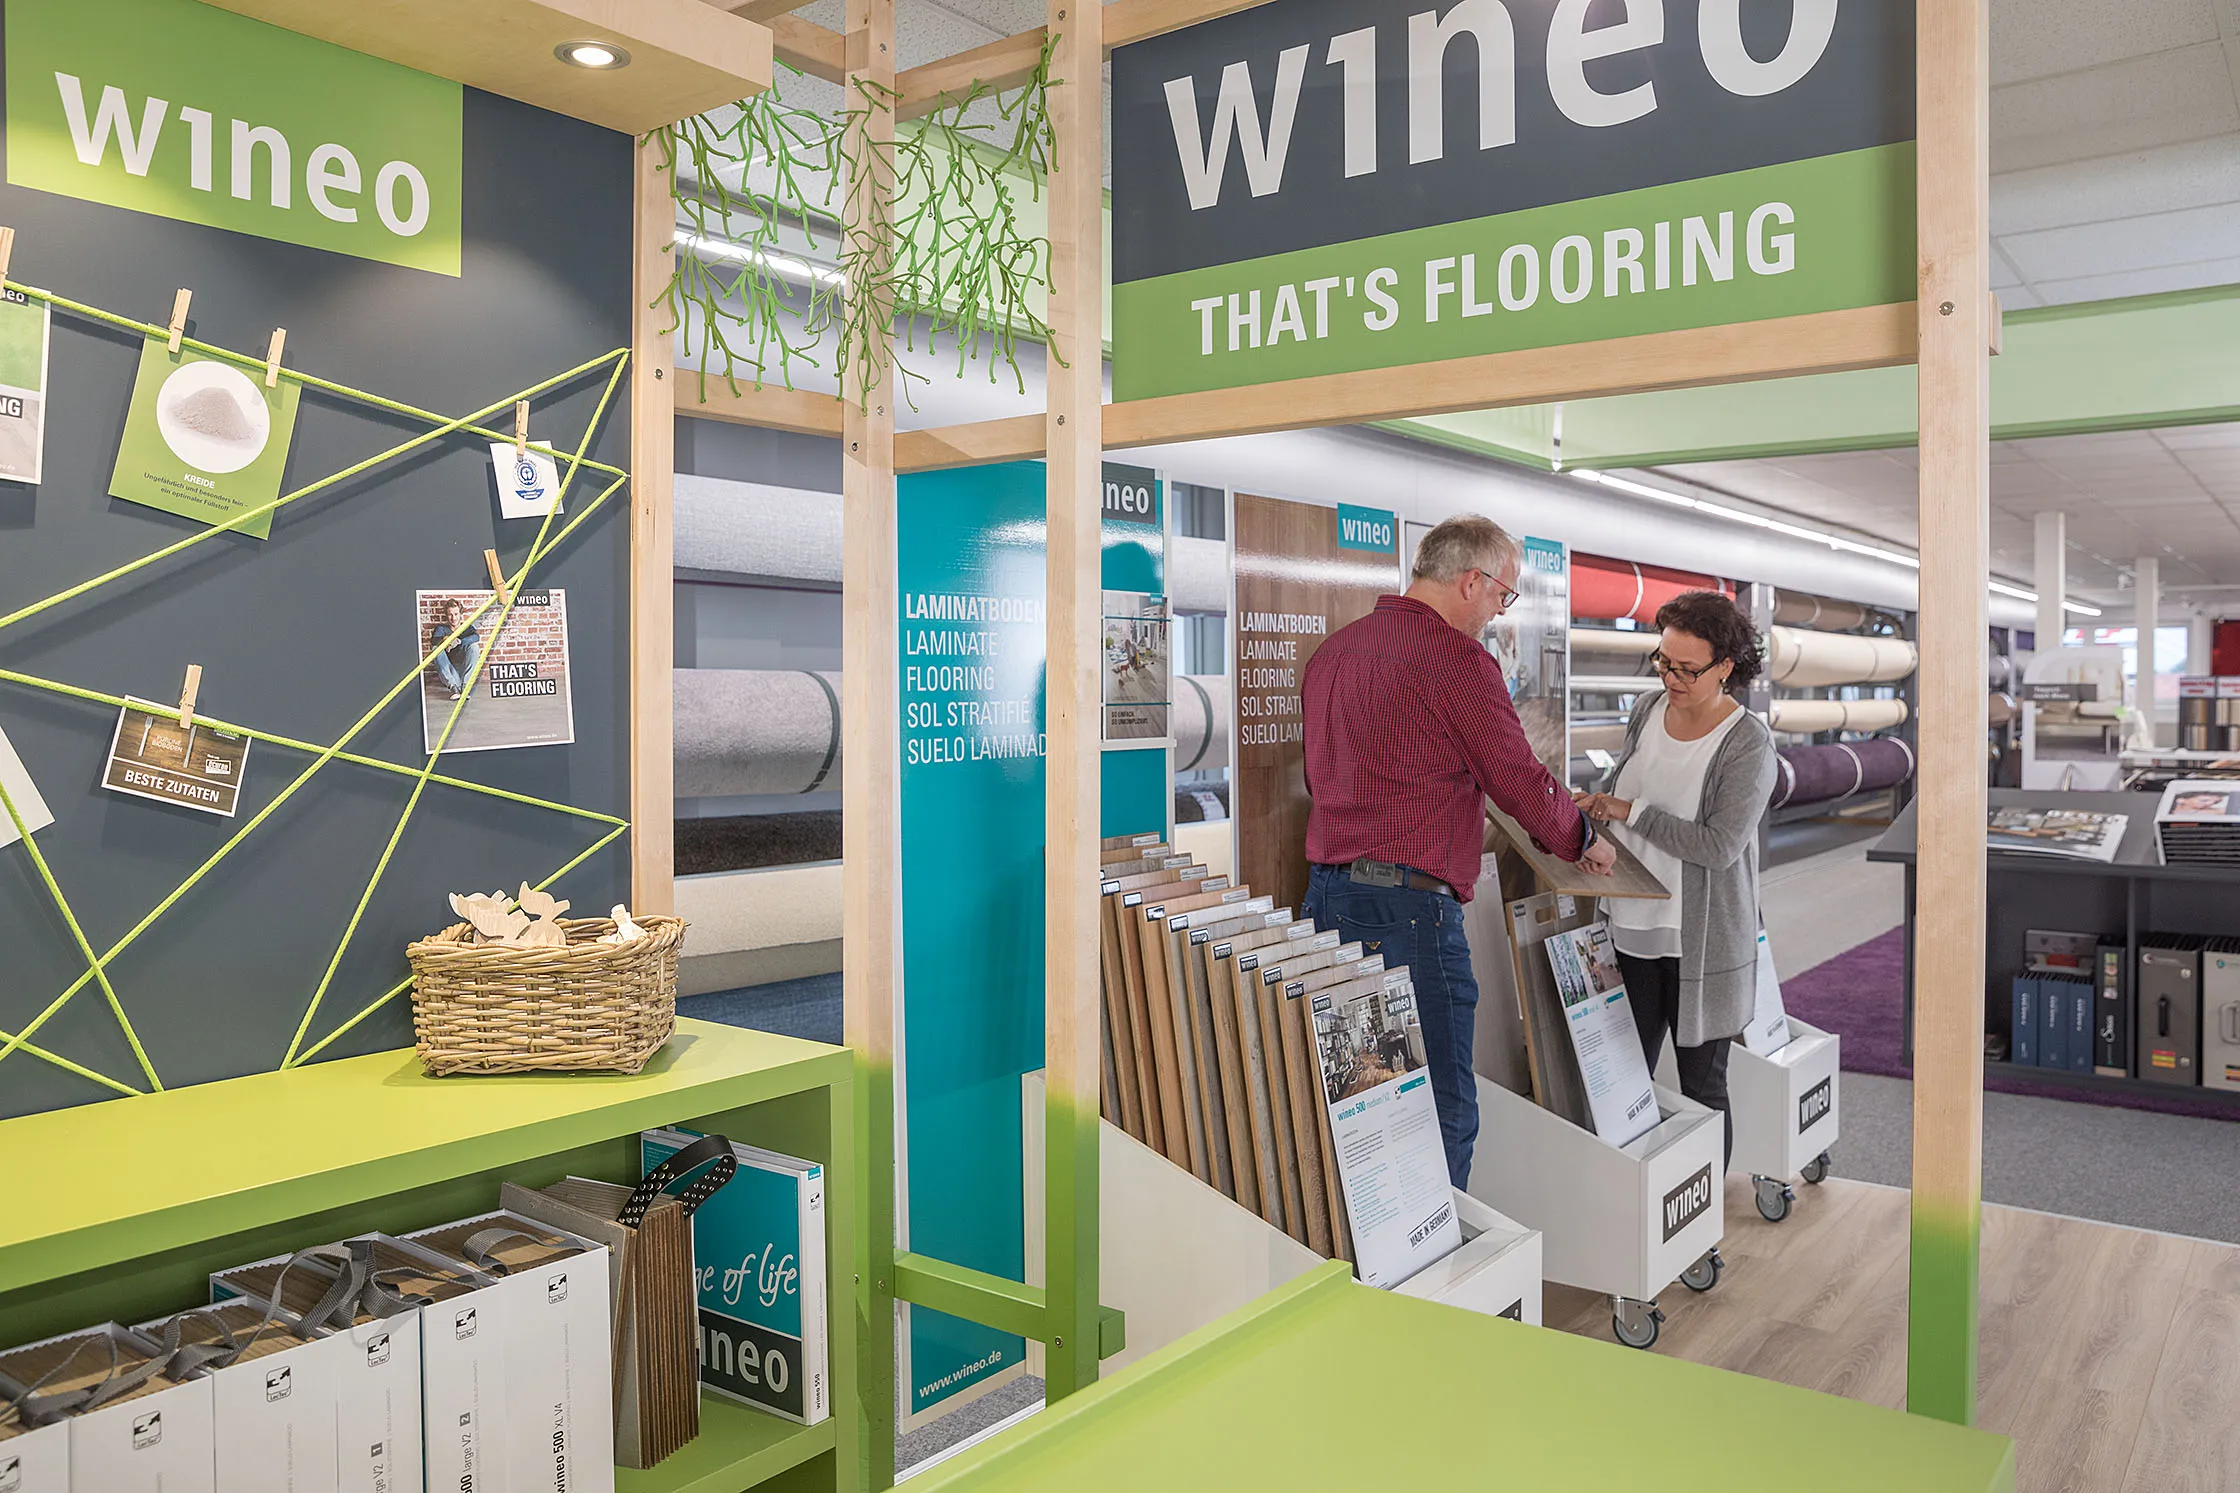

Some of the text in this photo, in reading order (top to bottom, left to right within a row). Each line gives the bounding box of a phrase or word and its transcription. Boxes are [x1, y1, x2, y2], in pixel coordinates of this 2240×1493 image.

[53, 71, 431, 238] wineo
[1192, 201, 1797, 356] THAT'S FLOORING
[183, 473, 216, 489] KREIDE
[160, 487, 171, 495] ein
[172, 490, 203, 504] optimaler
[185, 484, 199, 493] und
[199, 488, 231, 503] besonders
[1342, 518, 1391, 546] wineo
[1527, 548, 1560, 572] wineo
[516, 595, 548, 605] wineo
[905, 593, 1045, 623] LAMINATBODEN
[1240, 611, 1326, 635] LAMINATBODEN
[906, 630, 998, 656] LAMINATE
[1240, 640, 1297, 660] LAMINATE
[490, 664, 537, 679] THAT'S
[906, 666, 995, 692] FLOORING
[1241, 668, 1295, 688] FLOORING
[492, 681, 556, 697] FLOORING
[907, 694, 1030, 728] SOL STRATIFIÉ
[1241, 696, 1263, 717] SOL
[1241, 723, 1277, 745] SUELO
[907, 736, 964, 765] SUELO
[124, 770, 220, 803] BESTE ZUTATEN
[1388, 996, 1410, 1014] wineo
[1356, 1100, 1366, 1114] 500
[1800, 1085, 1829, 1124] wineo
[1666, 1175, 1708, 1229] wineo
[722, 1253, 756, 1306] of
[758, 1242, 798, 1308] life
[919, 1350, 1002, 1399] www.wineo.de
[462, 1432, 472, 1448] V2
[552, 1402, 566, 1493] wineo 500 XL V4
[373, 1464, 383, 1479] V2
[462, 1448, 474, 1473] large
